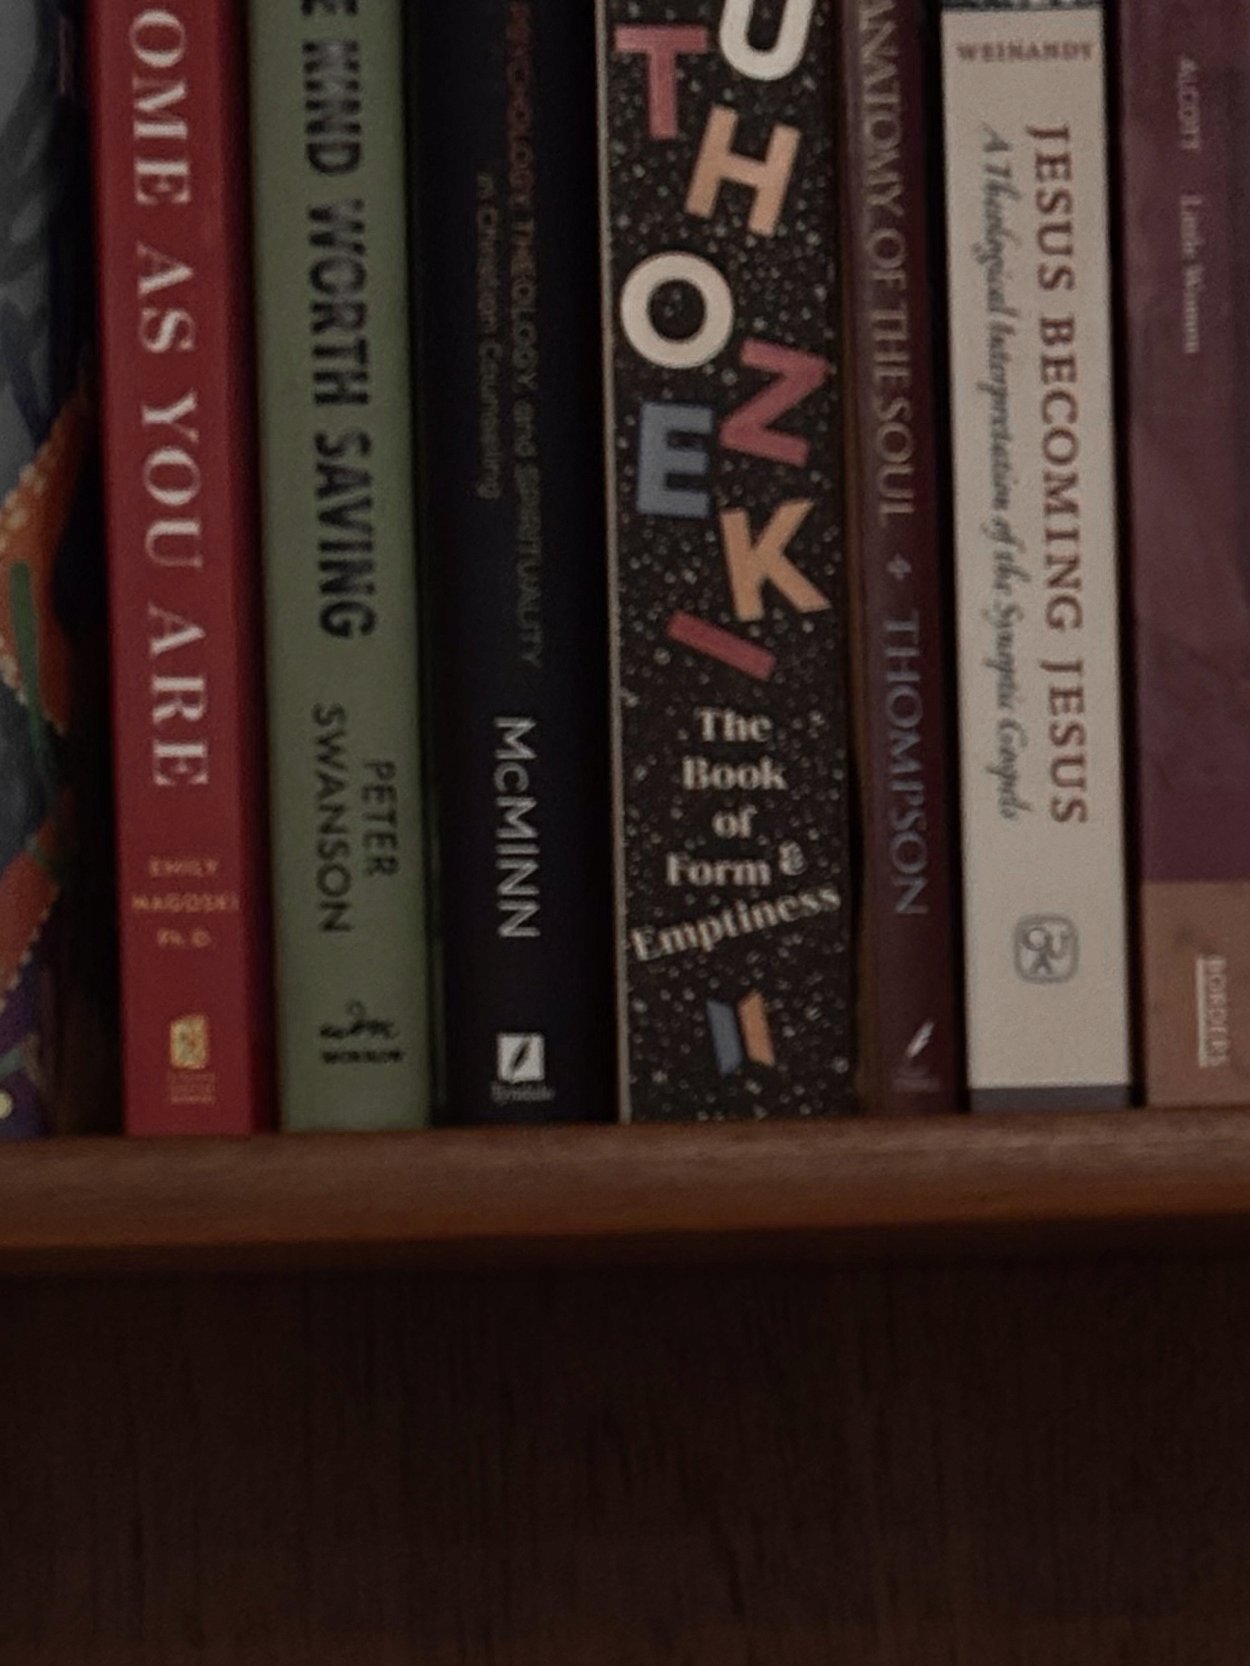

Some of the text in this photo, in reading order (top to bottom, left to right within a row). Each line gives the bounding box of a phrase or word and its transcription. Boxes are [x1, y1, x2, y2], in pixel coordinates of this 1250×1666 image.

[979, 124, 1015, 153] A
[865, 228, 908, 292] OF
[302, 39, 380, 641] KIND WORTH SAVING
[868, 304, 912, 388] THE
[870, 396, 917, 528] SOUL
[1025, 123, 1091, 824] JESUS BECOMING JESUS
[135, 240, 211, 790] AS YOU ARE
[681, 754, 791, 792] Book
[692, 705, 774, 744] The
[882, 609, 930, 916] THOMPSON
[312, 704, 354, 935] SWANSON
[360, 758, 401, 879] PETER
[493, 715, 541, 939] McMINN
[664, 850, 773, 888] Form
[710, 802, 758, 840] of
[630, 883, 843, 963] Emptiness
